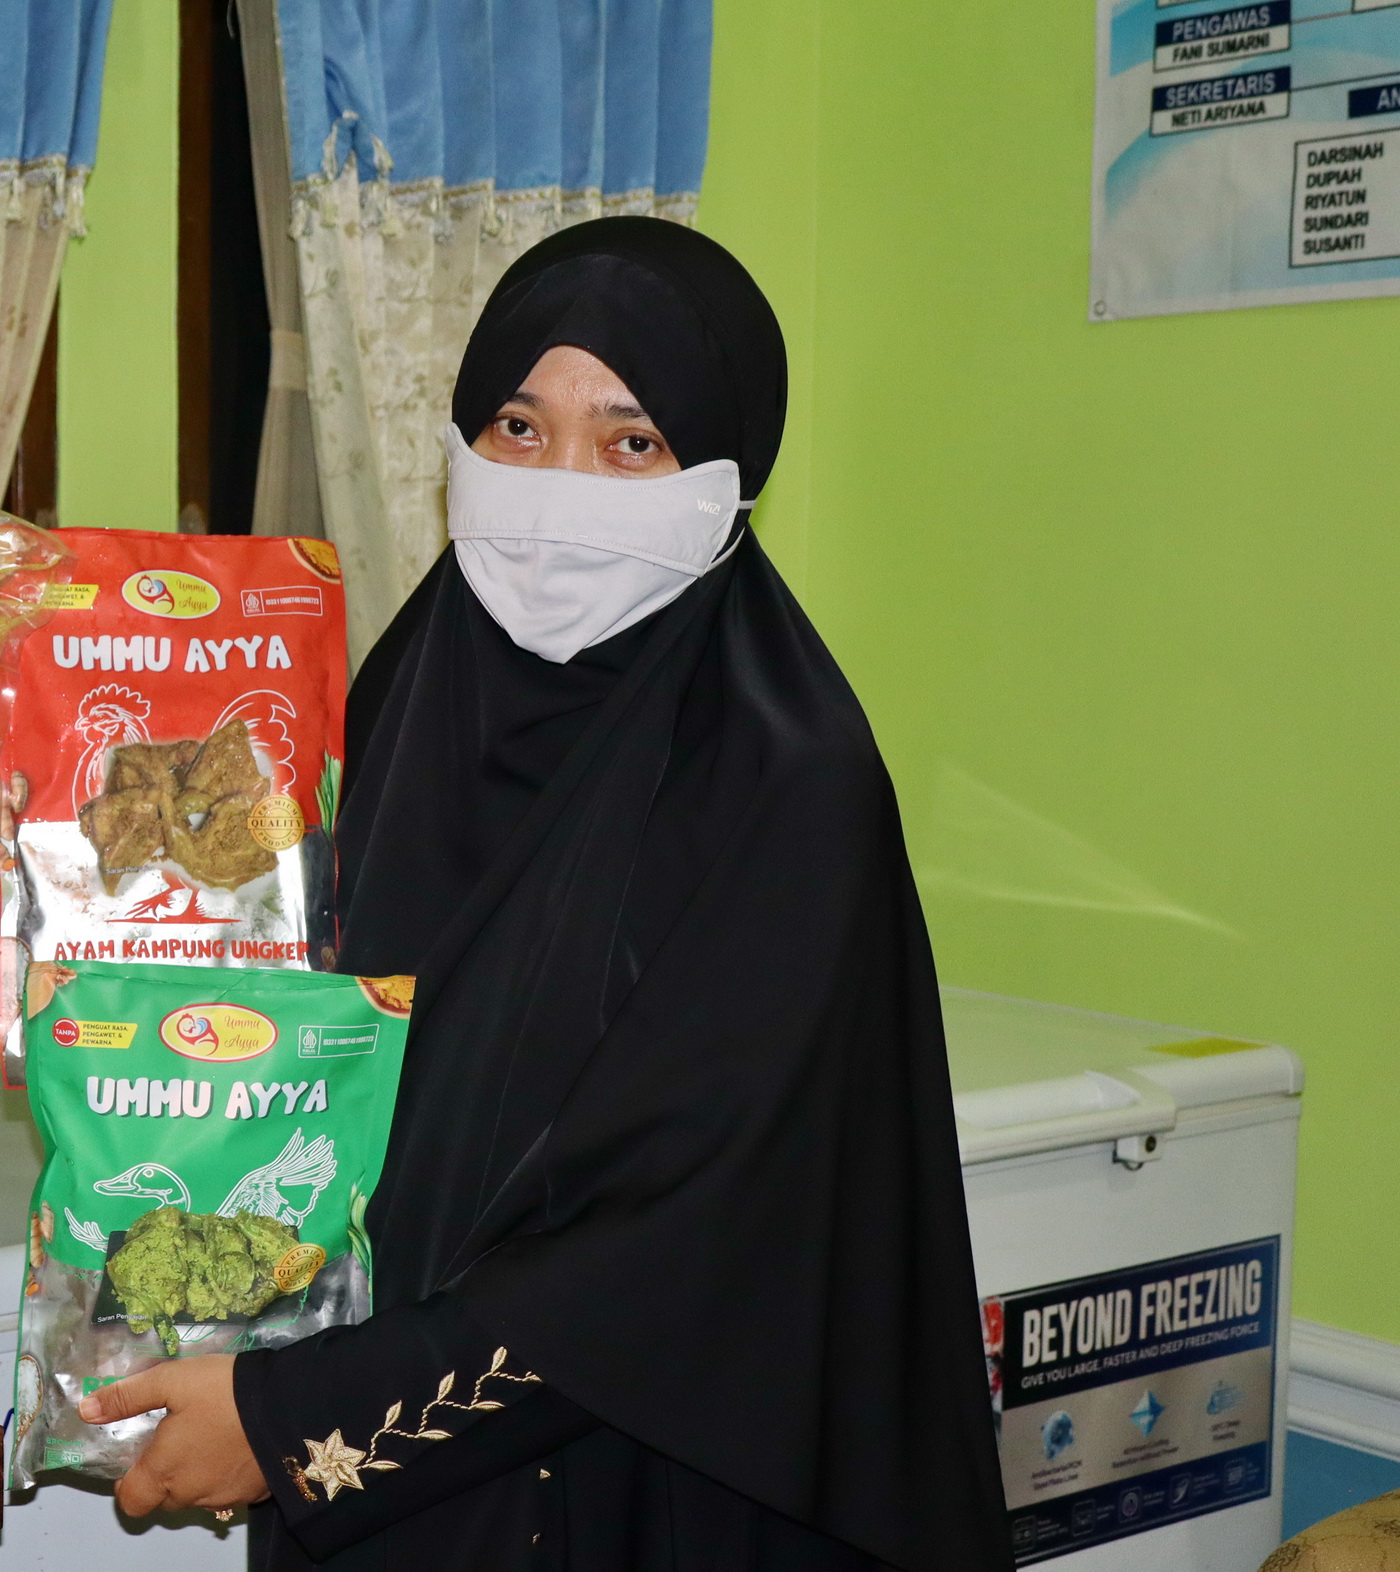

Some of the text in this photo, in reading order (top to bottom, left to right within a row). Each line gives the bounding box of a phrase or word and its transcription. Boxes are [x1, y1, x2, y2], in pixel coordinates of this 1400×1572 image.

[1172, 6, 1270, 41] PENGAWAS
[1172, 32, 1270, 62] FANI SUMARNI
[1165, 72, 1276, 108] SEKRETARIS
[1171, 100, 1266, 127] NETI ARIYANA
[1307, 142, 1384, 167] DARSINAH
[1306, 167, 1362, 189] DUPIAH
[1304, 189, 1366, 210] RIYATUN
[1303, 211, 1369, 233] SUNDARI
[1303, 234, 1366, 255] SUSANTI
[53, 635, 292, 673] UMMU AYYA
[251, 819, 301, 828] QUALITY
[54, 940, 309, 961] AYAM KAMPUNG UNGKEP
[55, 1028, 76, 1036] TANPA
[86, 1076, 329, 1120] UMMU AYYA
[97, 1314, 115, 1322] Saran
[1022, 1260, 1262, 1367] BEYOND FREEZING
[1021, 1373, 1044, 1389] GIVE
[1046, 1368, 1067, 1382] YOU
[1103, 1351, 1137, 1368] FASTER
[1139, 1345, 1159, 1359] AND
[1160, 1339, 1183, 1355] DEEP
[1185, 1328, 1228, 1349] FREEZING
